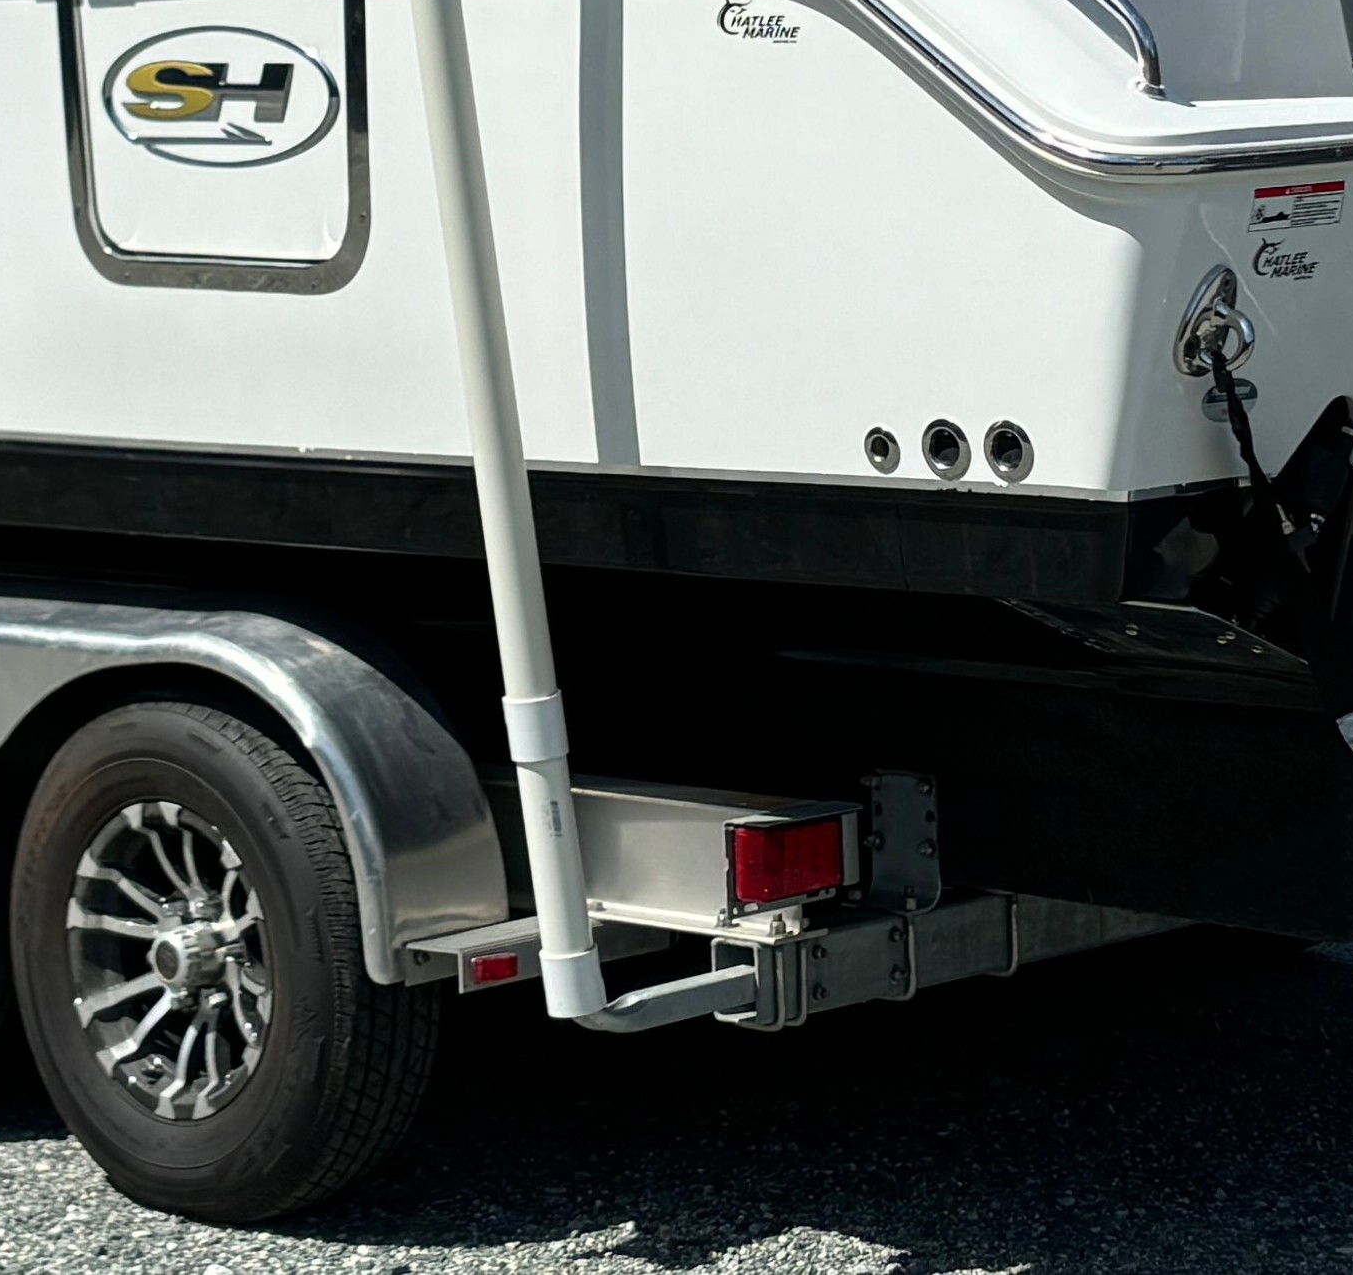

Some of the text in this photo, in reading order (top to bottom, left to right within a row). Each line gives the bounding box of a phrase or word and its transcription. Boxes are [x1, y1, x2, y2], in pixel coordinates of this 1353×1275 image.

[742, 26, 801, 39] MARINE
[122, 59, 295, 123] SH
[1270, 262, 1319, 278] MARINE
